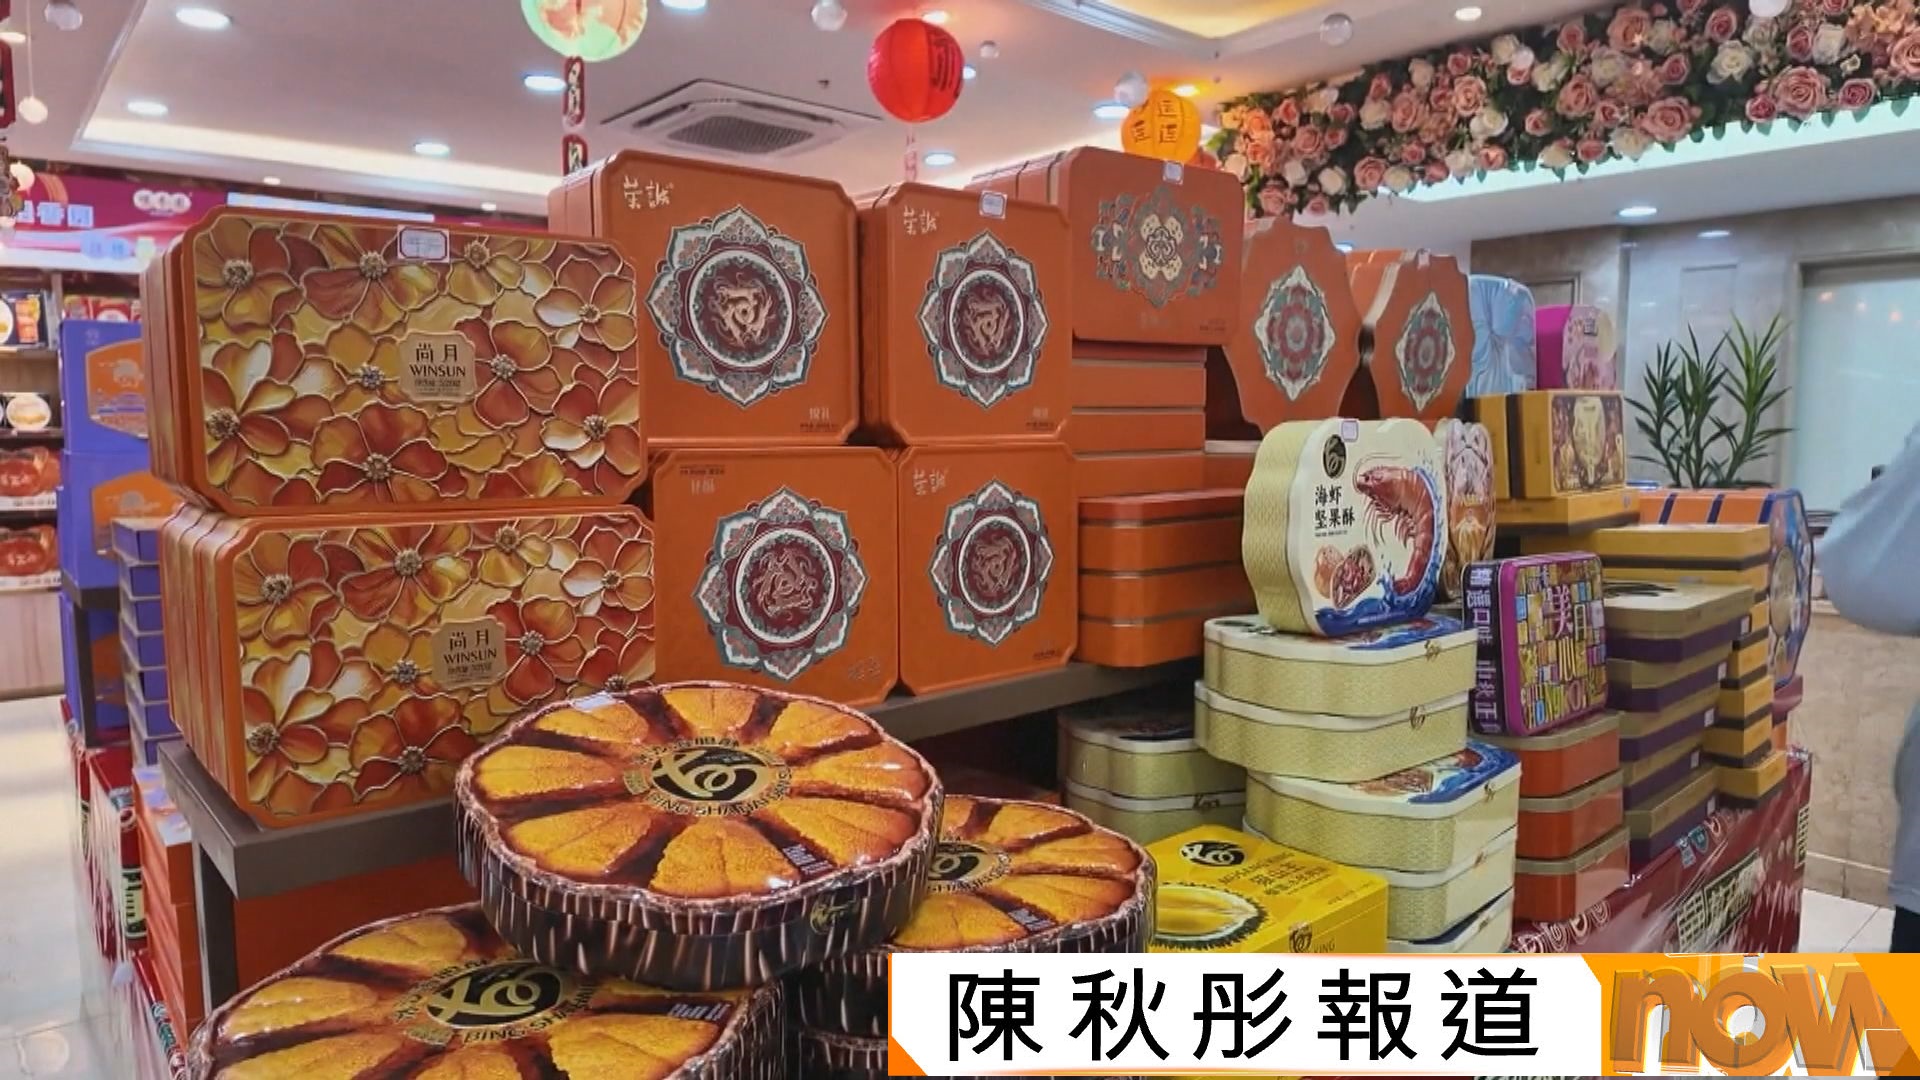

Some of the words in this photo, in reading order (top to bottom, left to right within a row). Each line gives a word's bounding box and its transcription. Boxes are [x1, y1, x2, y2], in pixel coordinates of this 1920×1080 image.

[415, 342, 458, 362] 尚月
[409, 363, 466, 377] WINSUN
[1314, 484, 1342, 506] 海虾
[449, 628, 489, 652] 尚月
[443, 648, 497, 664] WINSUN
